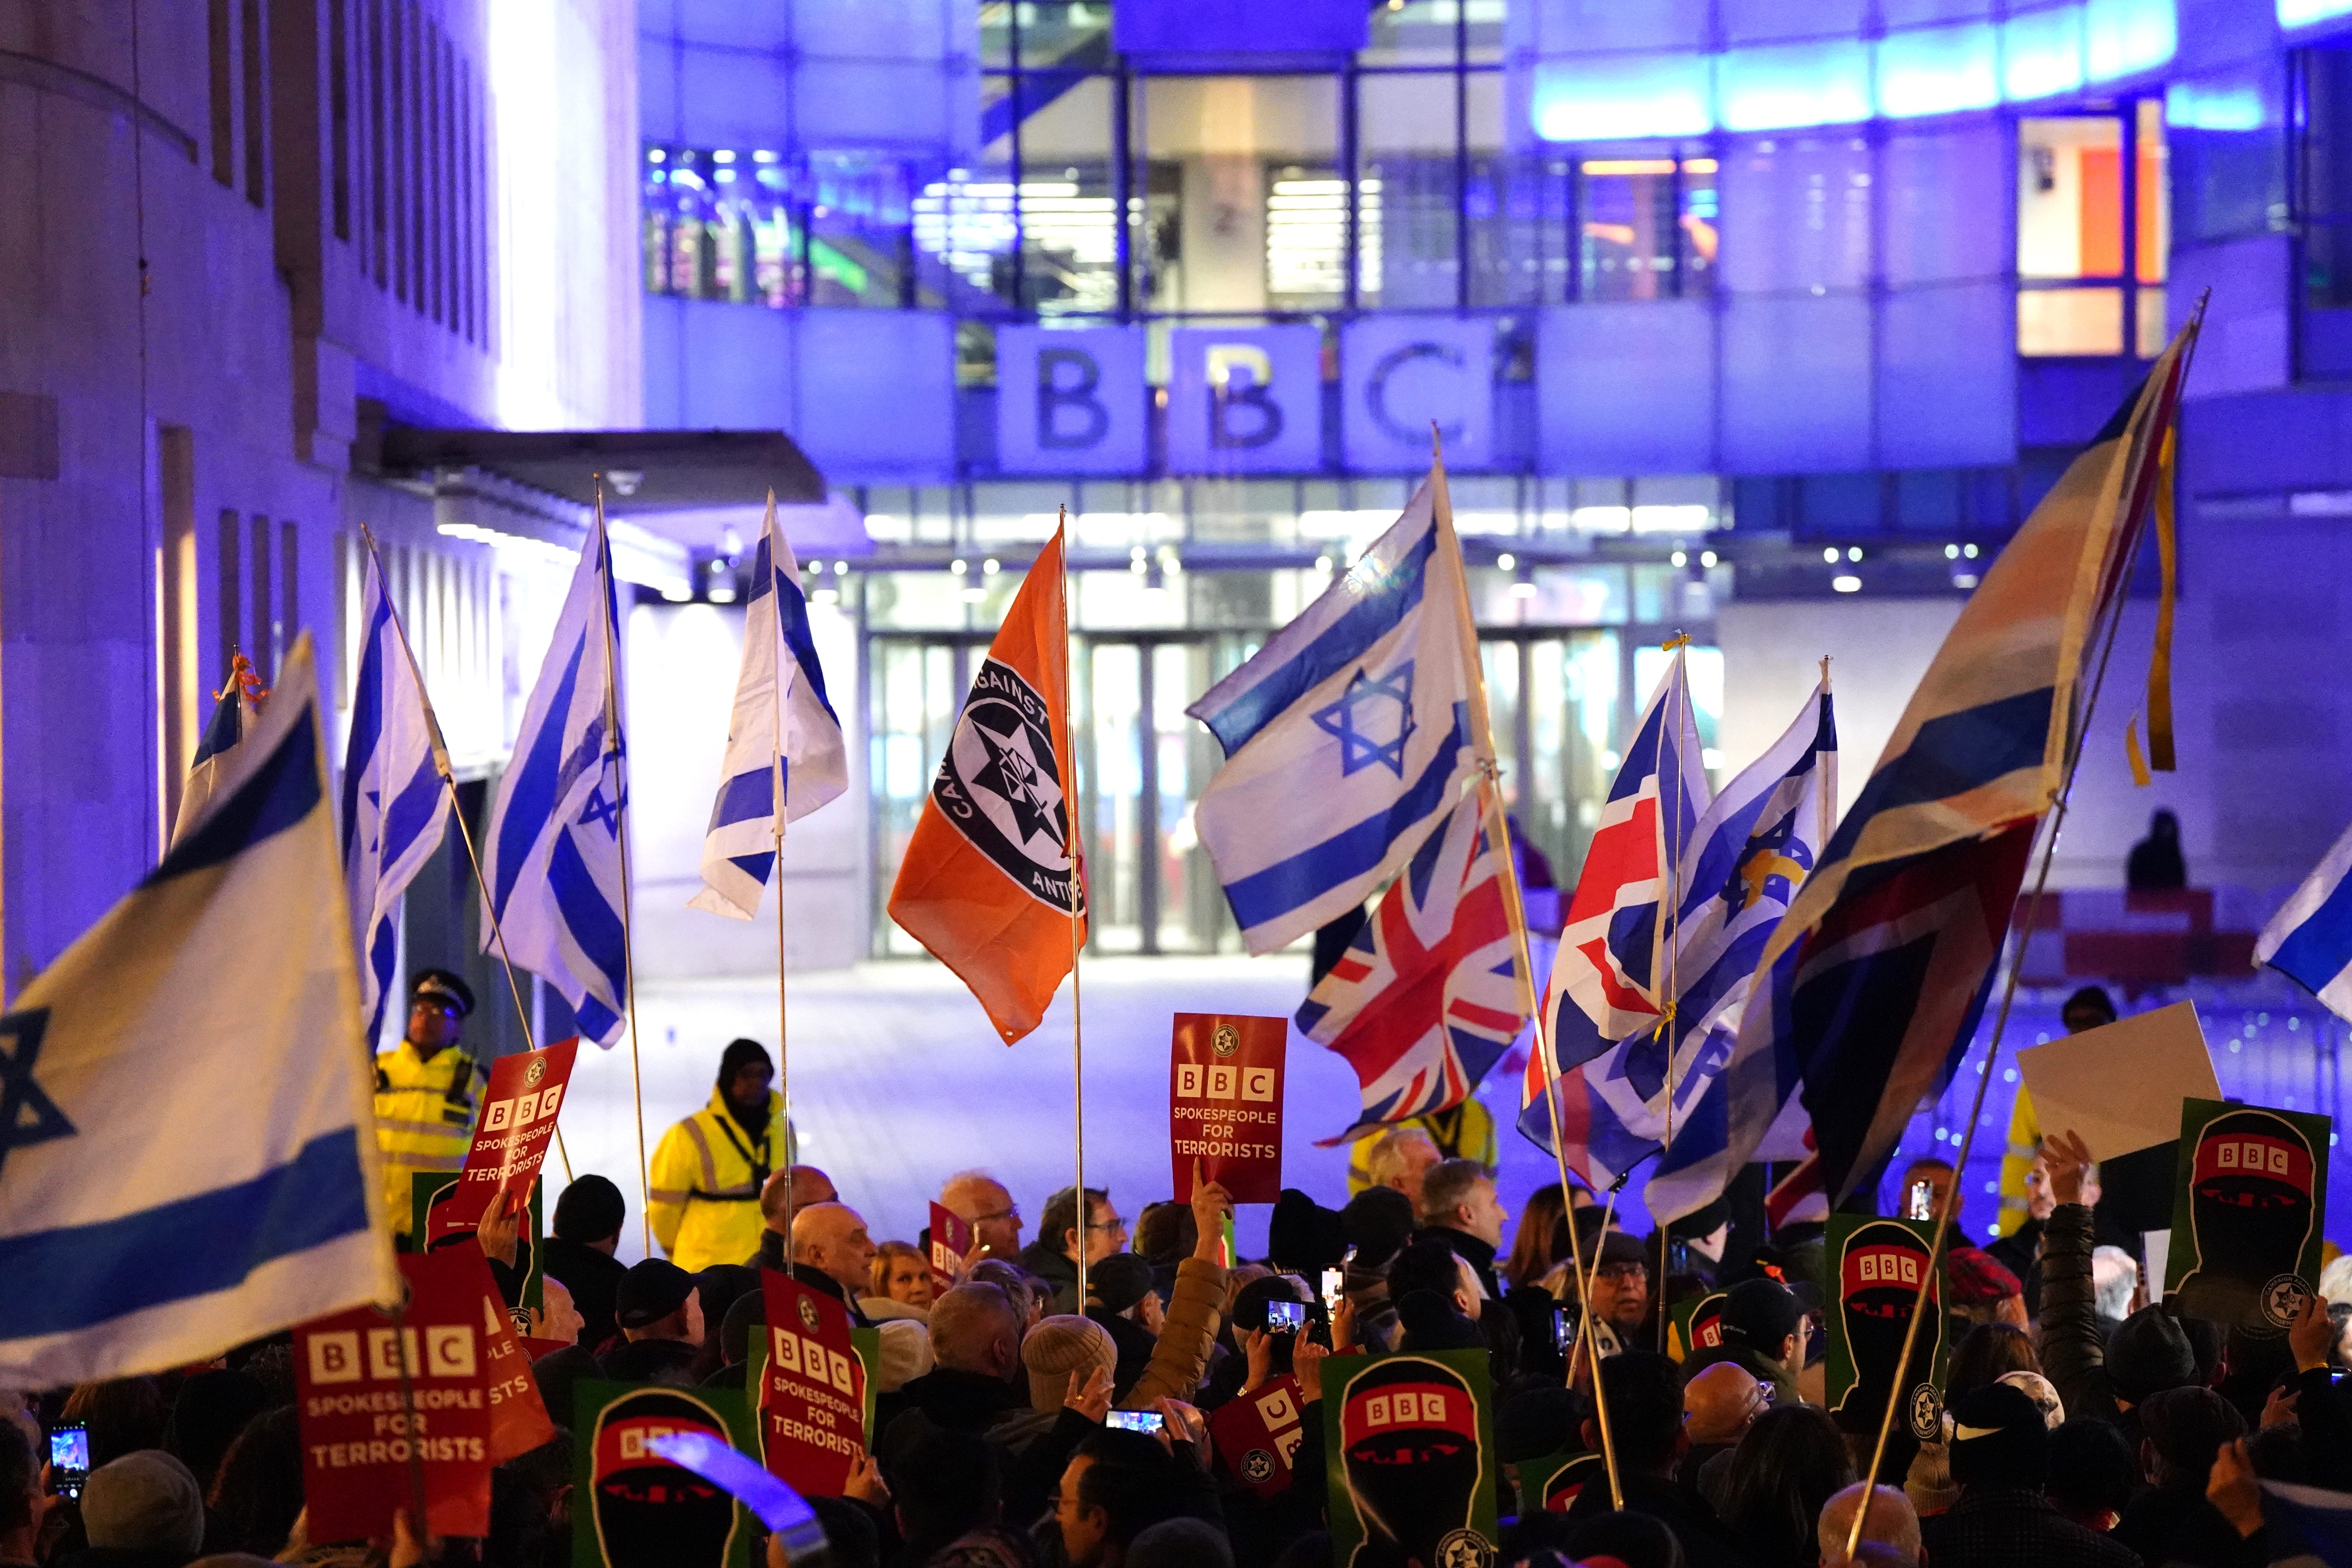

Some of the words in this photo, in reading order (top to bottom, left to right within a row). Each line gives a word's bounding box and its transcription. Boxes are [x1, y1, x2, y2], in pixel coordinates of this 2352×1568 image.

[1034, 340, 1467, 451] BBC
[973, 668, 1049, 725] GAINST
[1182, 1070, 1267, 1096] BBC
[491, 1091, 558, 1126] BBC
[1174, 1107, 1277, 1124] SPOKESPEOPLE
[475, 1121, 554, 1151] SPOKESPEOPLE
[1202, 1124, 1233, 1139] FOR
[1174, 1139, 1276, 1159] TERRORISTS
[2221, 1146, 2285, 1171] BBC
[467, 1150, 544, 1181] TERRORISTS
[1863, 1257, 1915, 1280] BBC
[780, 1338, 848, 1385] BBC
[307, 1388, 484, 1417] SPOKESEOPLE
[774, 1376, 860, 1423] SPOKESPEOPLE
[1371, 1397, 1441, 1421] BBC
[373, 1412, 428, 1437] FOR
[807, 1406, 837, 1429] FOR
